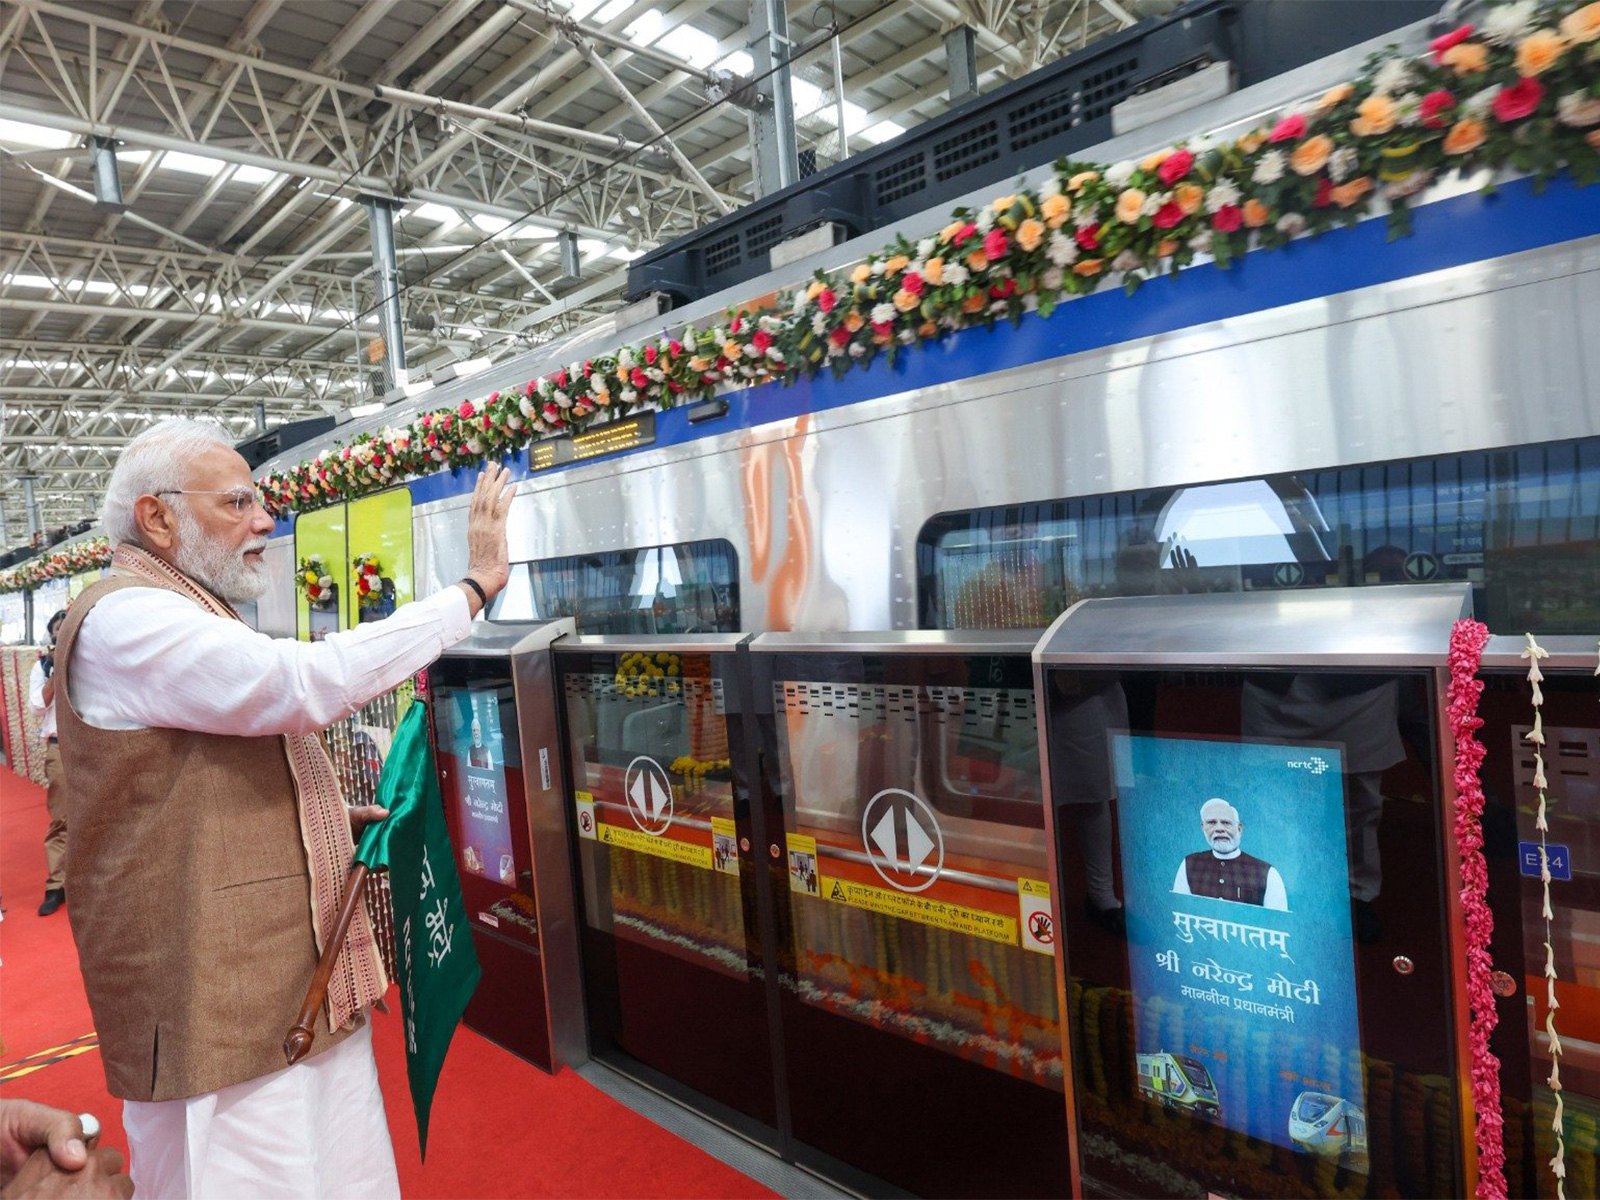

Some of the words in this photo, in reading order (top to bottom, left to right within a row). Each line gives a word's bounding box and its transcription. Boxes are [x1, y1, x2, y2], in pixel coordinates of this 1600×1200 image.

[1287, 761, 1313, 770] ncrtc
[959, 923, 973, 932] AND
[1172, 911, 1295, 964] सुस्वागतम्
[1155, 950, 1181, 973] श्री
[1191, 958, 1253, 991] नरेन्द्र
[1266, 972, 1321, 1005] मोदी
[1181, 985, 1230, 1007] माननीय
[1233, 997, 1295, 1023] प्रधानमंत्री
